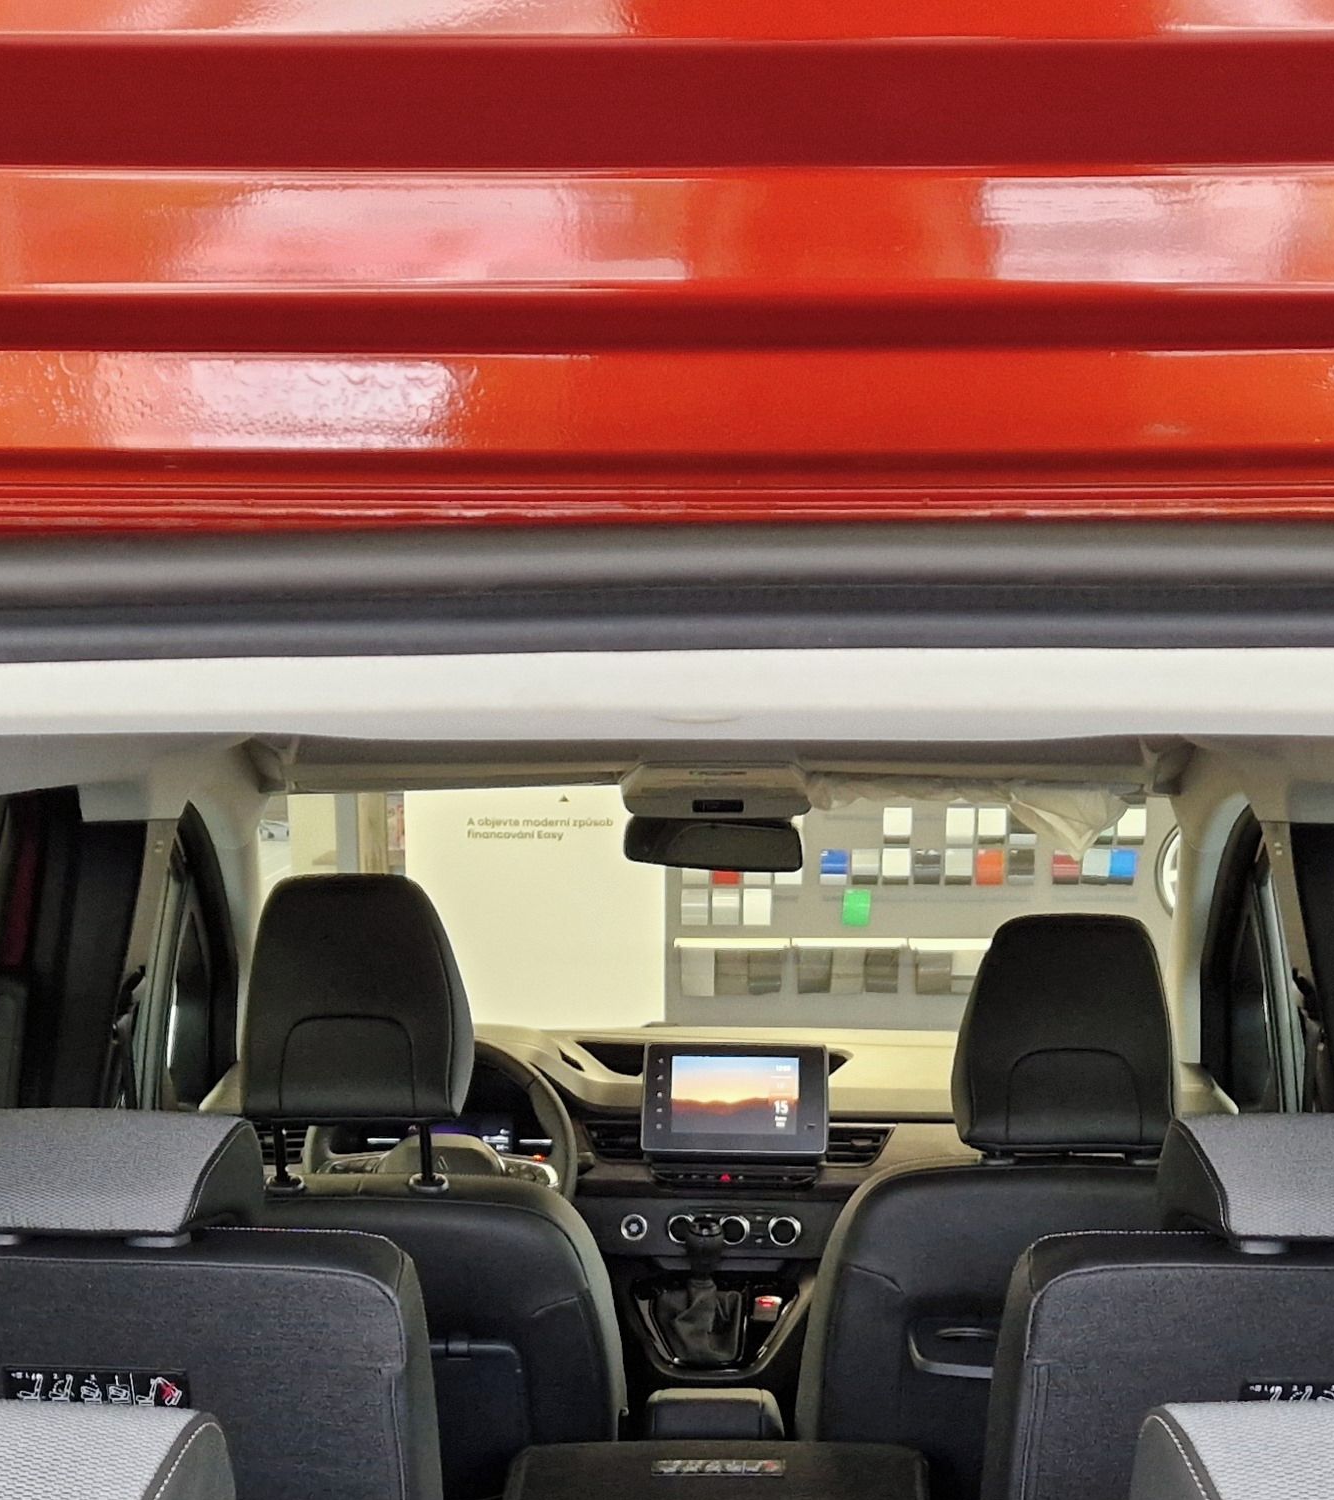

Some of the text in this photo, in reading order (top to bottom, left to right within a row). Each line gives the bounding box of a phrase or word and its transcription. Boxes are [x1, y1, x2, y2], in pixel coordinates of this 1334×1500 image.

[467, 817, 614, 829] A objevte moderní způsob
[467, 830, 564, 842] financování Easy
[774, 1100, 788, 1114] 15
